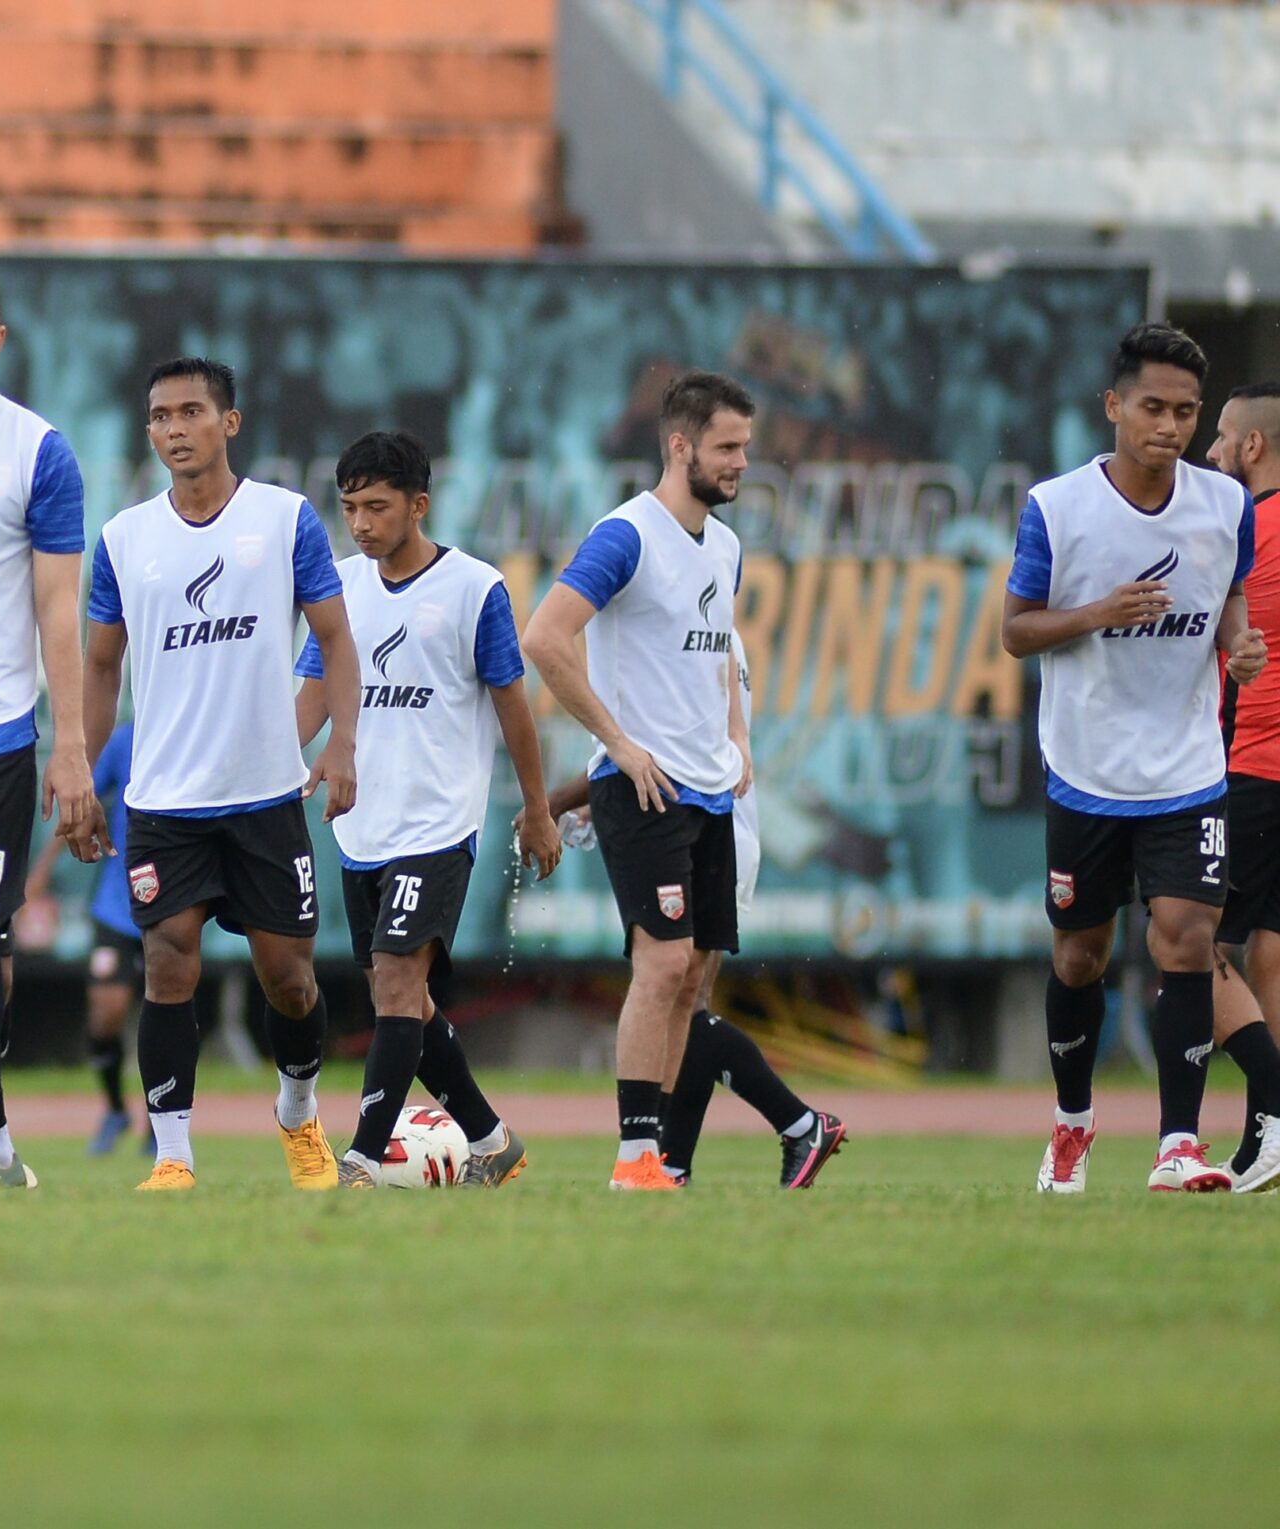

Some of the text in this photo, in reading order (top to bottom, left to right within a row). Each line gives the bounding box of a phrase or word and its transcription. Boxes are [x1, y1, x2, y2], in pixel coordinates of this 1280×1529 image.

[162, 615, 259, 652] ETAMS
[360, 685, 435, 709] TAMS
[1200, 817, 1226, 857] 38
[293, 855, 314, 893] 12
[391, 874, 423, 912] 76
